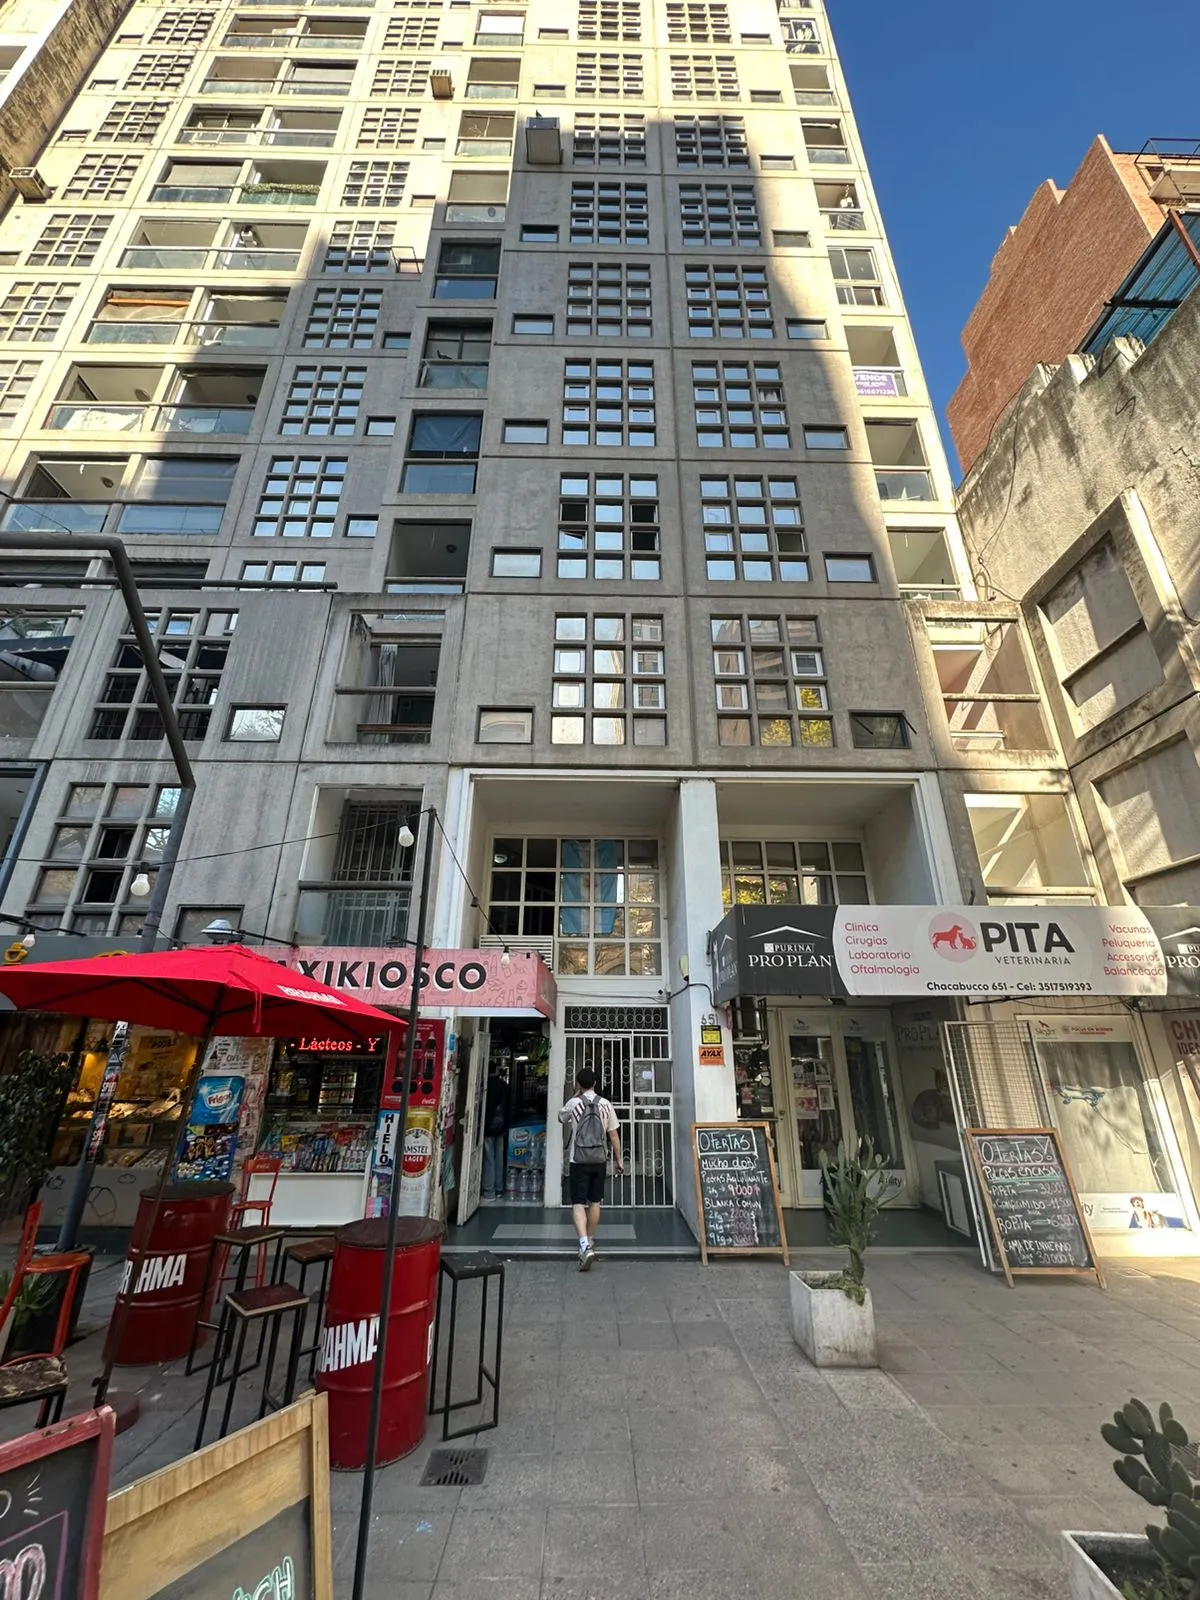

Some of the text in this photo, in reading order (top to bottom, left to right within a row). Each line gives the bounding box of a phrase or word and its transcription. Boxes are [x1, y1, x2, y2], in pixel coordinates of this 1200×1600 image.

[1109, 924, 1152, 934] Vacunas
[980, 922, 1076, 953] PITA
[774, 944, 812, 952] PURINA
[849, 950, 911, 960] Laboratorio
[995, 956, 1072, 965] VETERINARIA
[1107, 953, 1160, 962] Accesorios
[276, 960, 487, 991] XIKIOSCO
[1103, 966, 1165, 976] Balanceado
[926, 981, 989, 991] Chacabucco
[992, 982, 1007, 991] 651
[1017, 982, 1036, 991] Cel:
[1039, 982, 1093, 992] 3517519393
[701, 1013, 719, 1025] 651
[299, 1037, 353, 1051] Lácteos
[368, 1037, 381, 1052] Y
[380, 1113, 395, 1165] HIELO
[318, 1316, 381, 1373] RAHMA
